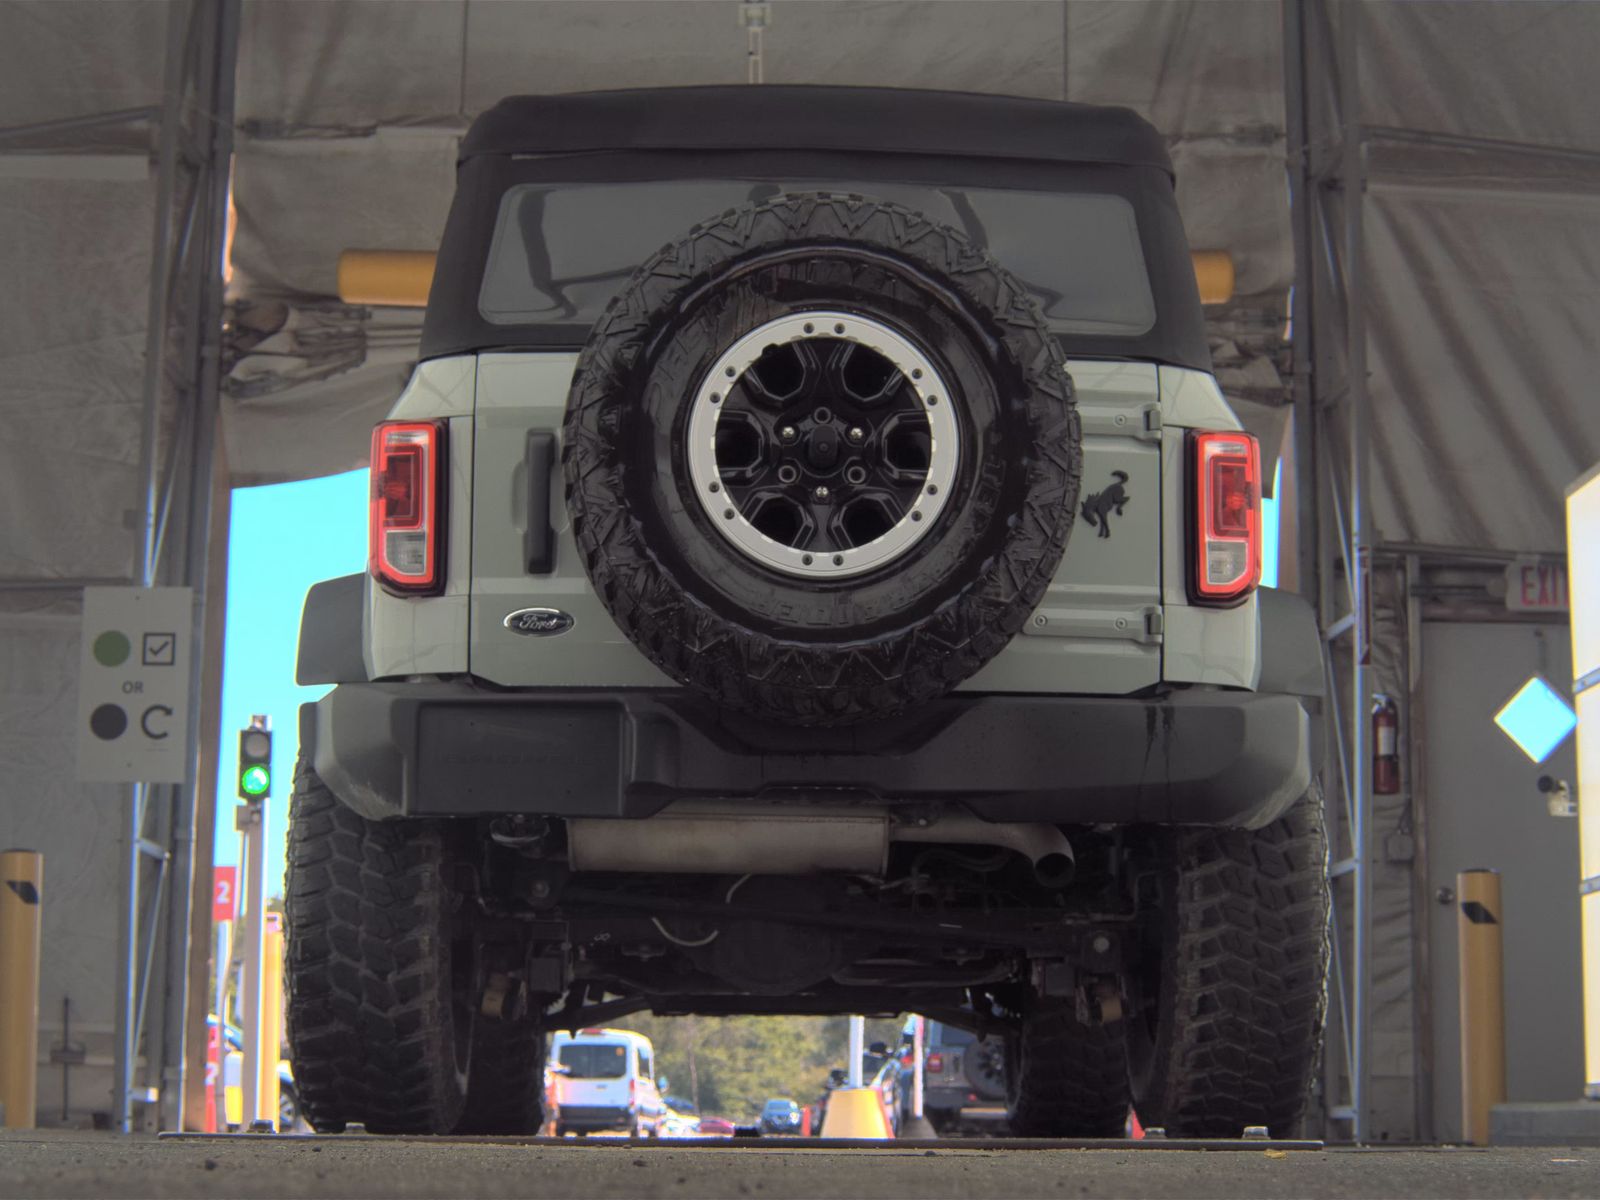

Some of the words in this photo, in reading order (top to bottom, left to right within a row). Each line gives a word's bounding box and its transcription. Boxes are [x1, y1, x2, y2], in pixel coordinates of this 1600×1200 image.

[519, 612, 558, 631] Ford
[122, 680, 144, 695] OR
[217, 881, 230, 904] 2
